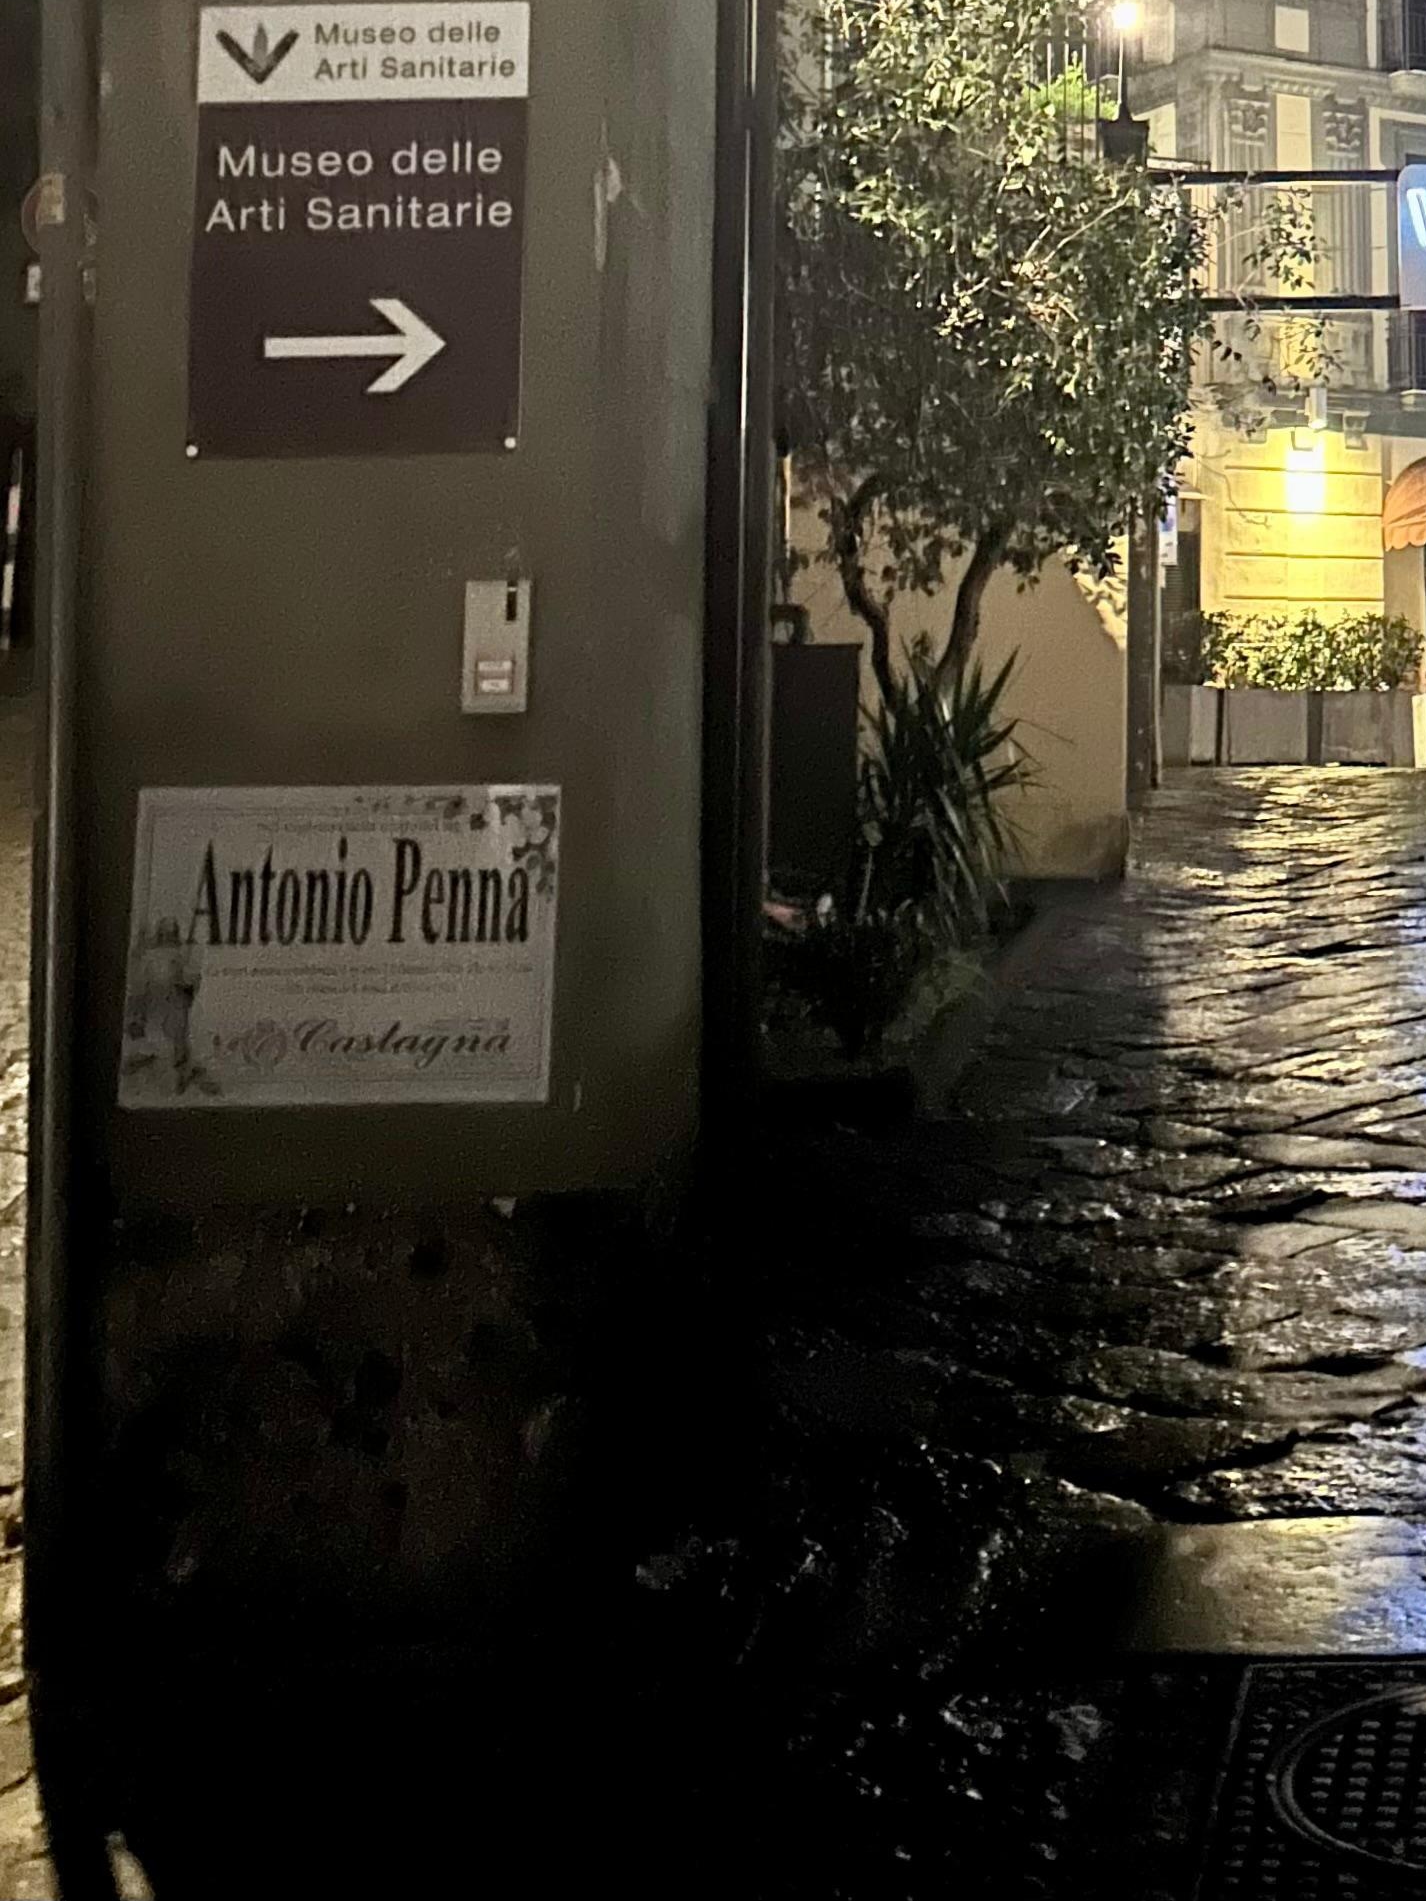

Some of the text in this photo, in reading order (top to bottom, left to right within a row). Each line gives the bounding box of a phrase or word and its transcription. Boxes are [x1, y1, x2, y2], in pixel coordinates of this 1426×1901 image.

[313, 20, 501, 46] Museo delle
[313, 53, 517, 81] Arti Sanitarie
[217, 140, 504, 178] Museo delle
[204, 193, 514, 233] Arti Sanitarie
[186, 836, 530, 947] Antonio Penna
[294, 1017, 512, 1069] Castagna
